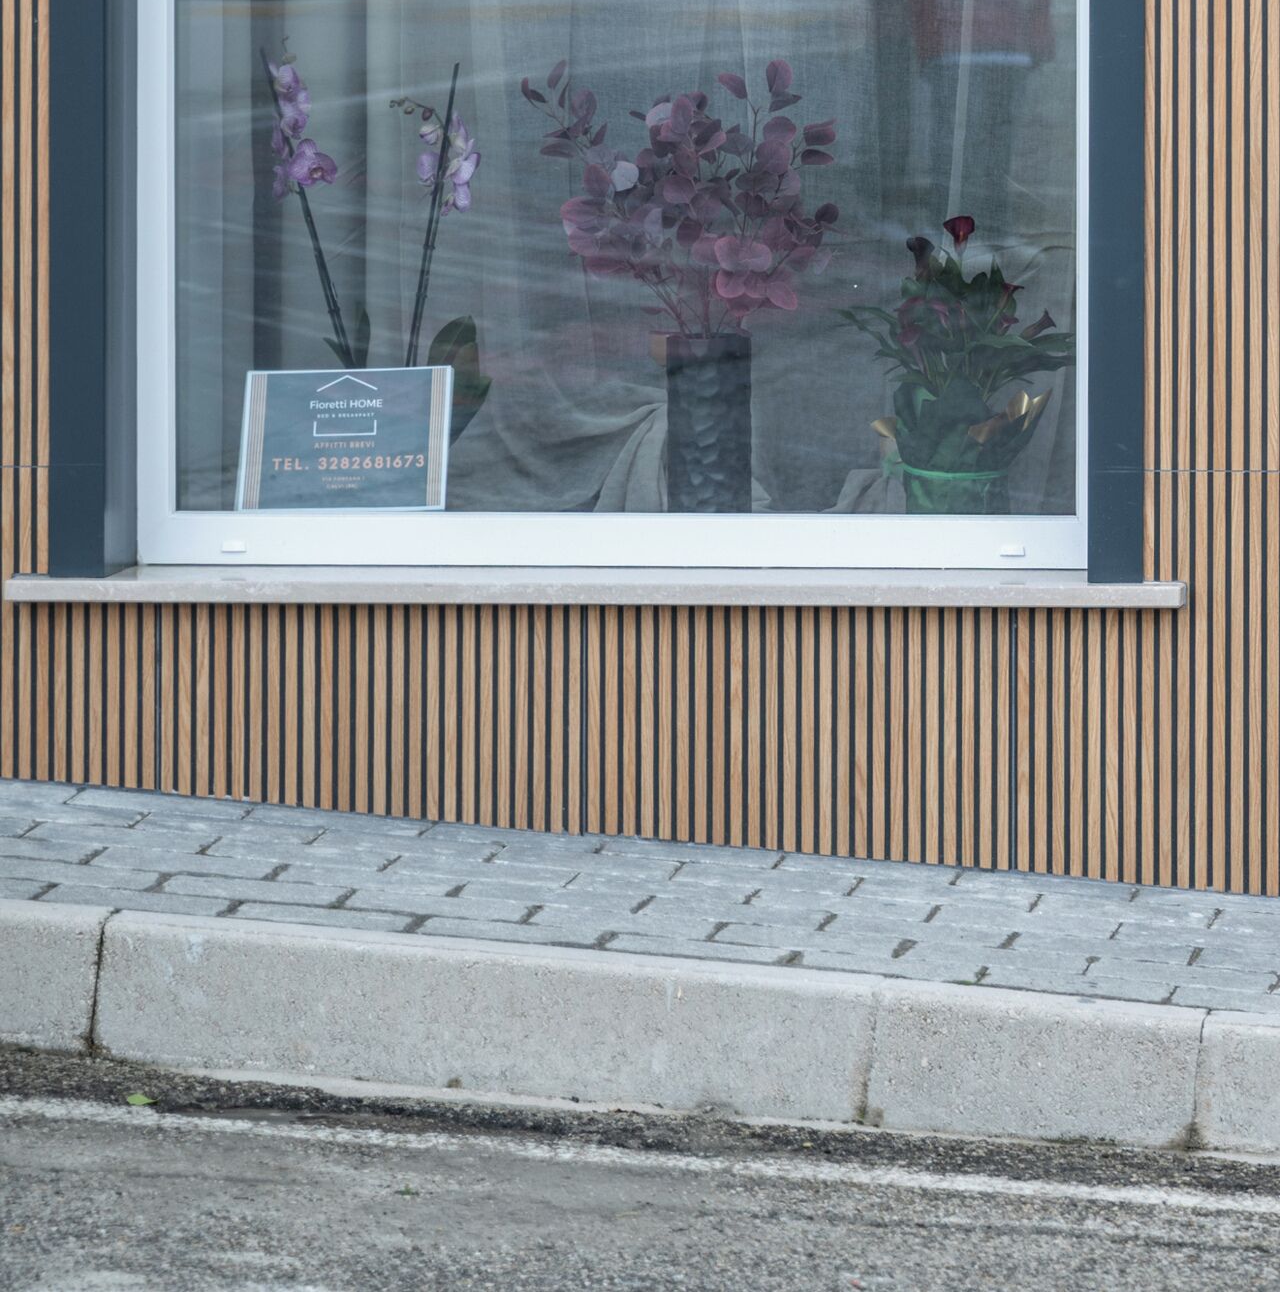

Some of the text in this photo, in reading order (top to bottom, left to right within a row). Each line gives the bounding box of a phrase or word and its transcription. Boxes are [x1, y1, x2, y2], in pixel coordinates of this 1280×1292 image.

[309, 398, 384, 410] Fioretti HOME
[314, 440, 375, 450] AFFITTI BREVI
[272, 454, 425, 471] TEL. 3282681673
